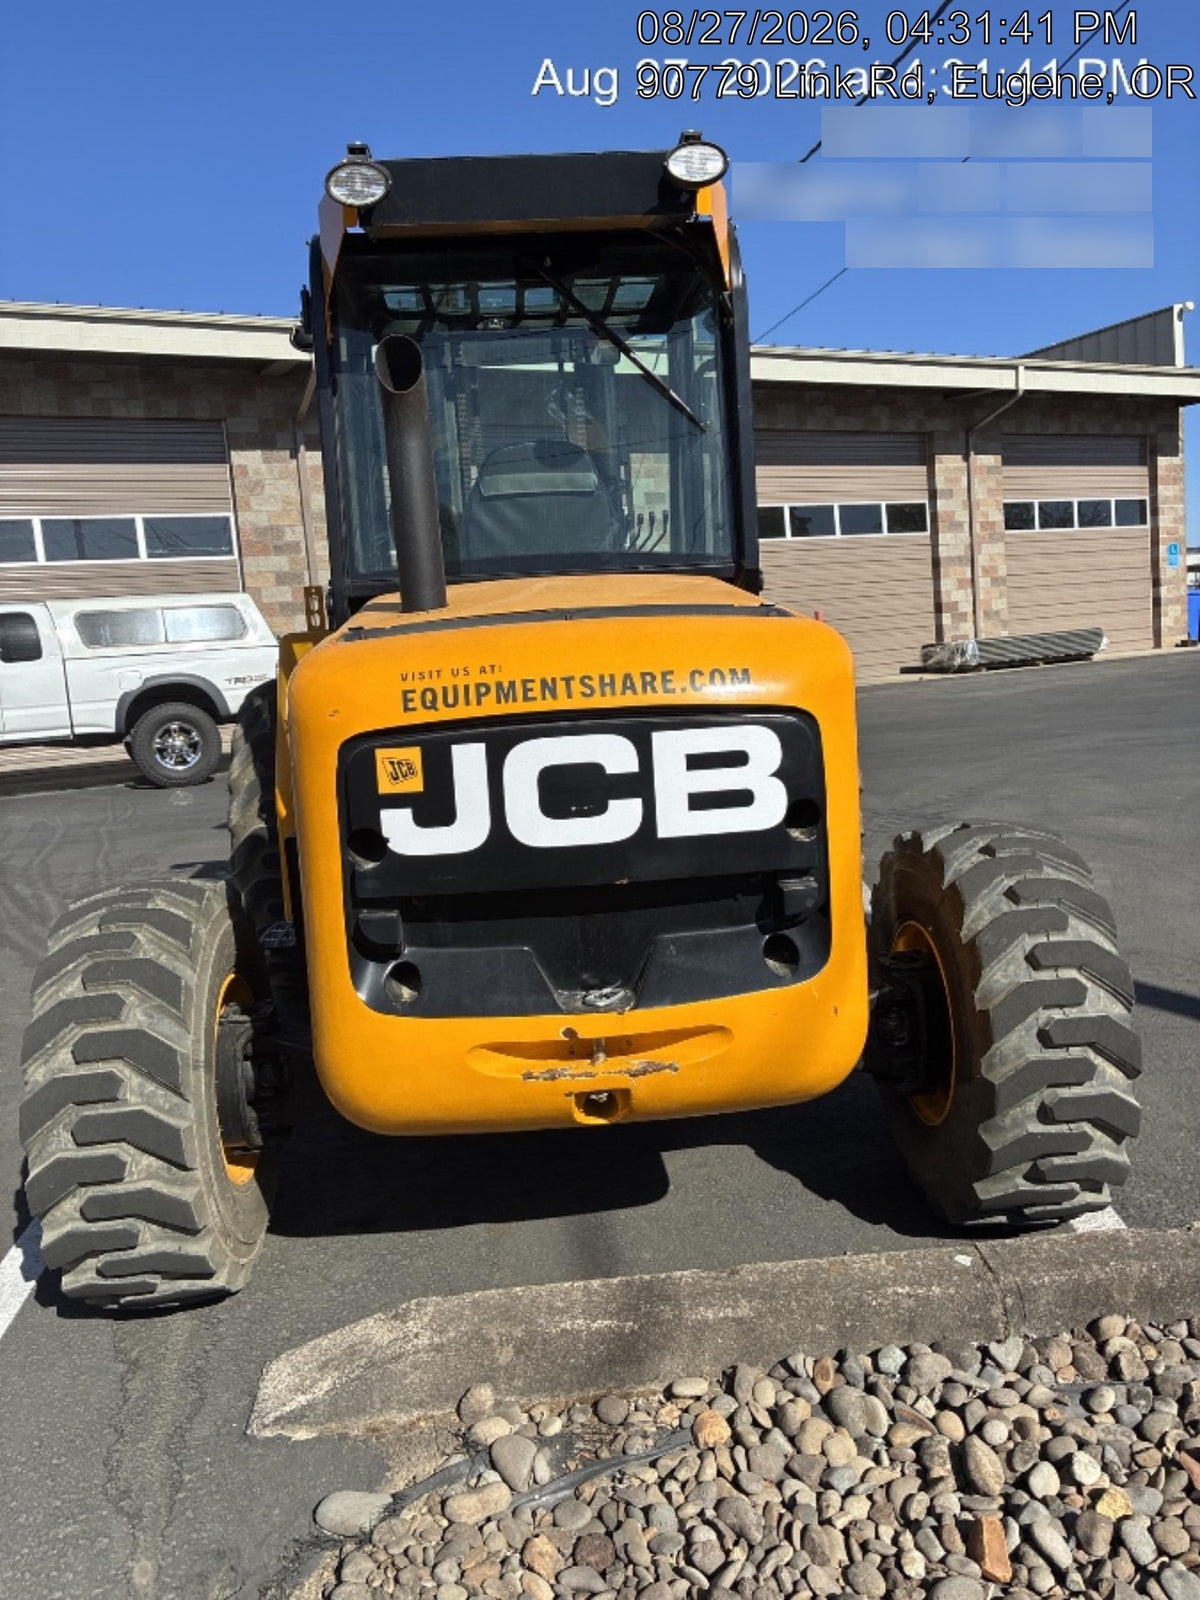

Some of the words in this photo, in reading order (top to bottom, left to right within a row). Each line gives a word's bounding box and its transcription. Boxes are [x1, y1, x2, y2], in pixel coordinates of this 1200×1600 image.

[400, 669, 442, 682] VISIT
[451, 666, 470, 678] US
[401, 667, 751, 713] EQUIPMENTSHARE.COM
[387, 759, 416, 782] JCB
[379, 724, 788, 856] JCB
